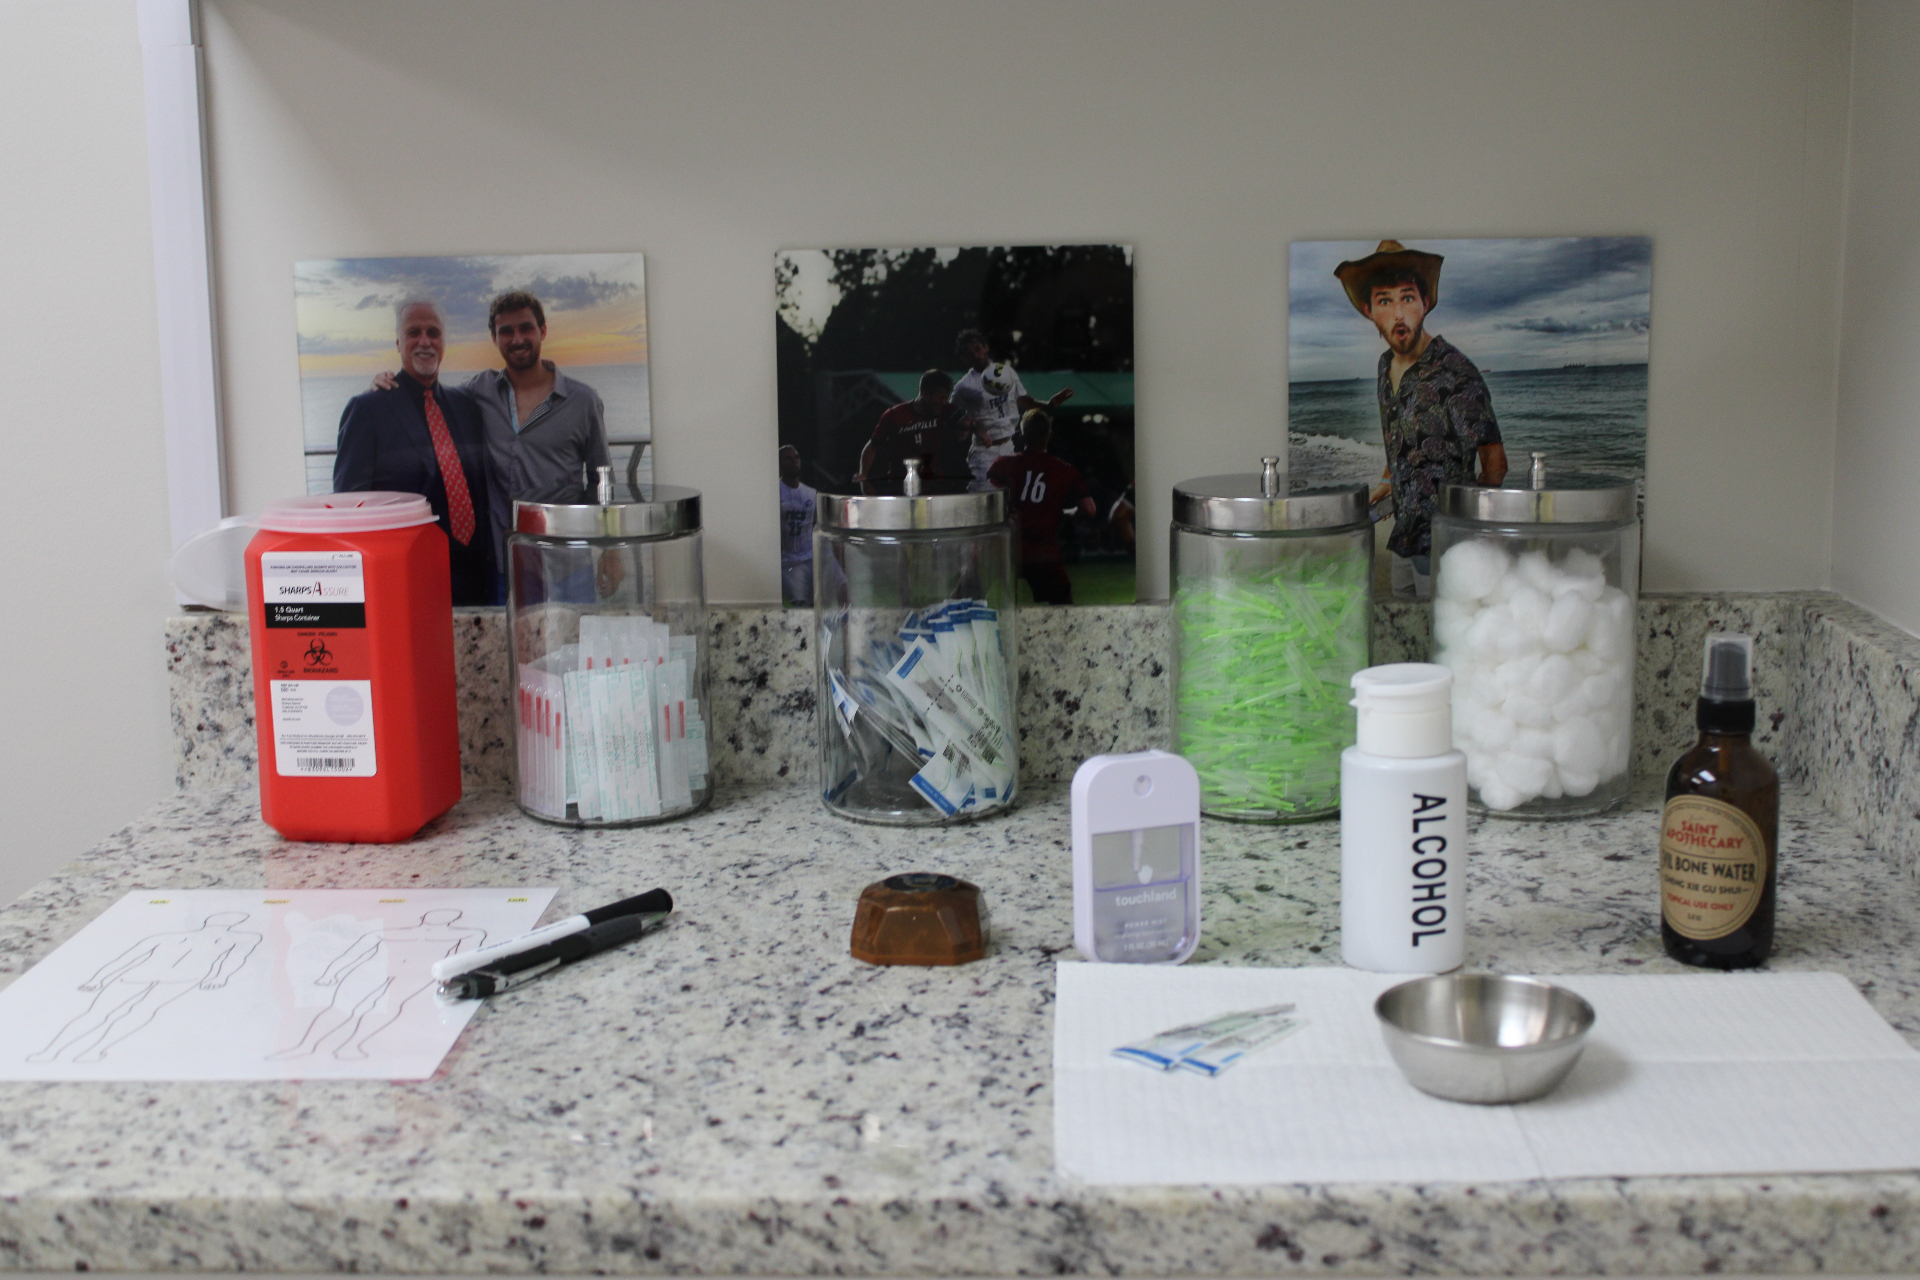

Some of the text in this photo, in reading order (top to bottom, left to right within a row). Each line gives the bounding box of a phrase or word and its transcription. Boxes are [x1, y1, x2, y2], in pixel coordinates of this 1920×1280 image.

[1020, 470, 1046, 504] 16
[274, 614, 321, 623] Sharps Container
[285, 605, 304, 614] Quart
[1666, 826, 1745, 849] APOTHECARY
[1681, 820, 1718, 836] SAINT
[1412, 793, 1447, 947] ALCOHOL
[1675, 856, 1708, 875] BONE
[1712, 863, 1755, 882] WATER
[1115, 888, 1177, 907] touchland
[1693, 901, 1708, 909] USE
[1709, 903, 1735, 911] ONLY
